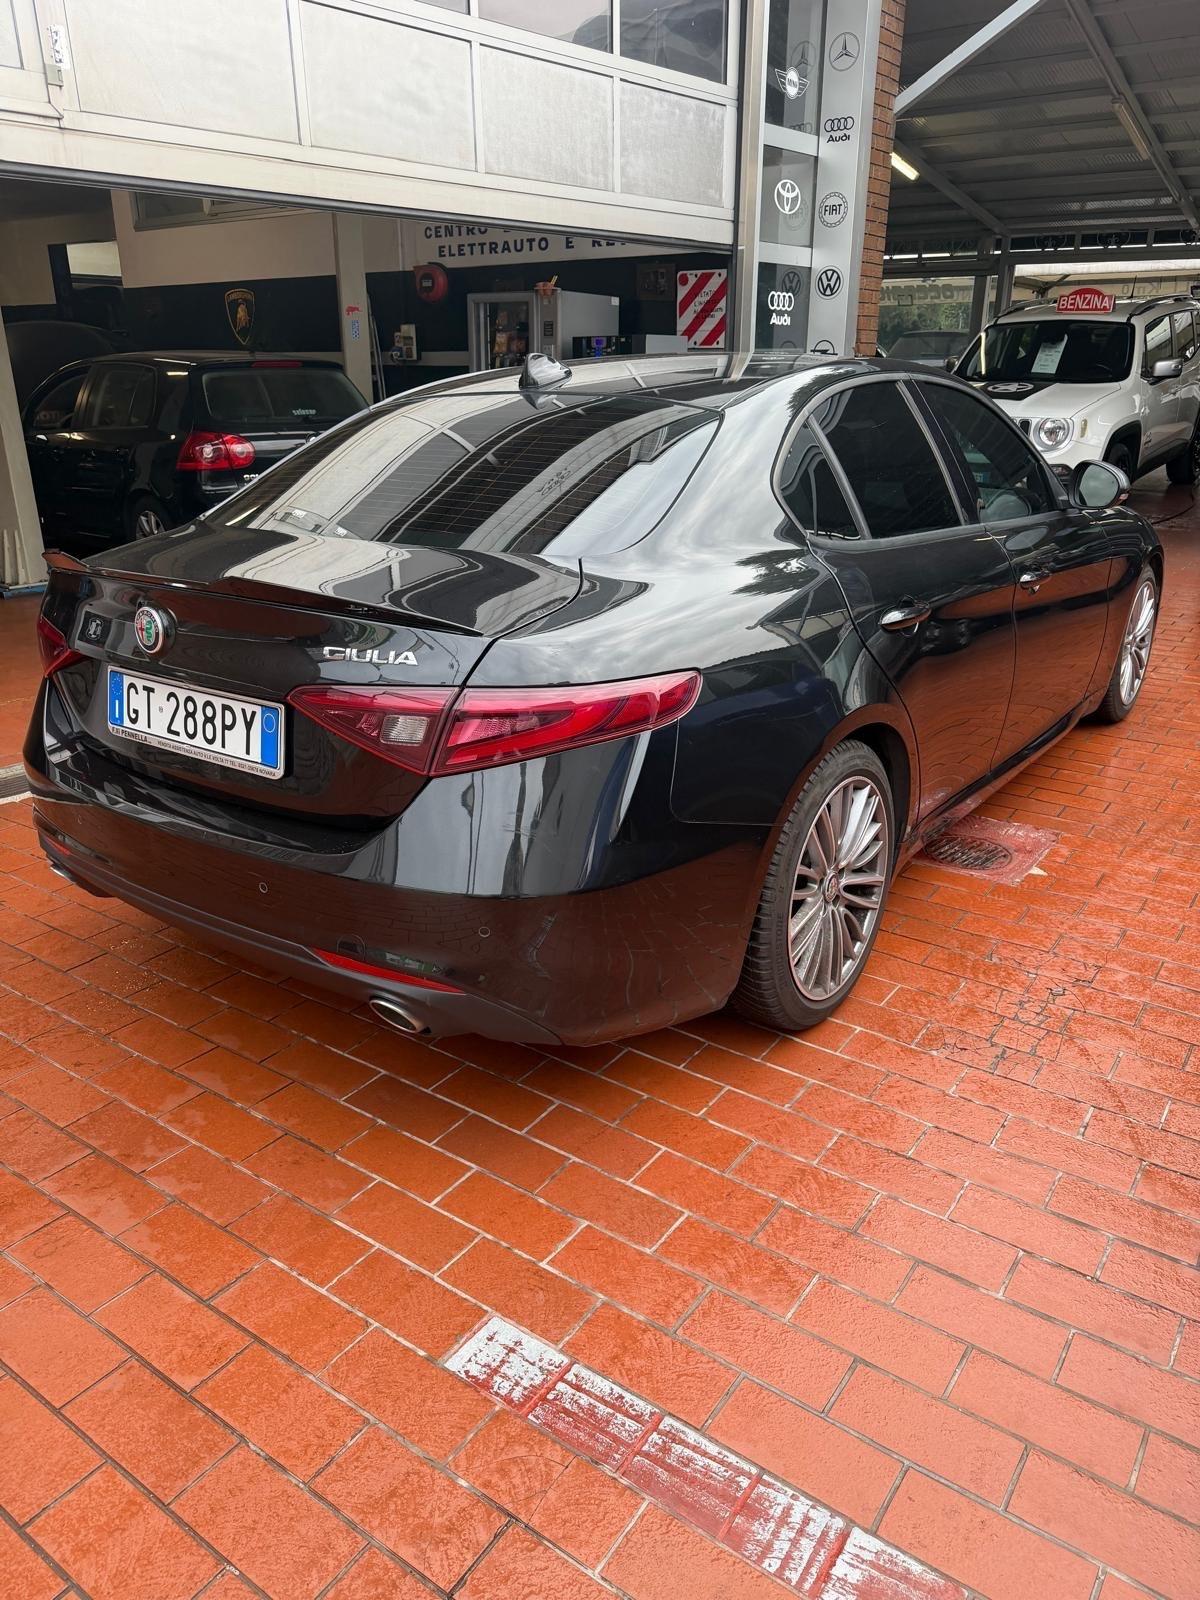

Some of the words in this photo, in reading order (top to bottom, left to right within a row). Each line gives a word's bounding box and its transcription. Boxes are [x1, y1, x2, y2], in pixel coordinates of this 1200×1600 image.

[826, 133, 851, 143] Audi
[823, 203, 843, 217] FIAT
[438, 236, 549, 258] ELETTRAUTO
[565, 237, 575, 249] E
[1058, 295, 1111, 310] BENZINA
[769, 312, 791, 326] Audi
[323, 646, 419, 666] GIULIA
[126, 682, 155, 729] GT
[166, 691, 257, 756] 288PY
[121, 728, 148, 744] PENNELLA
